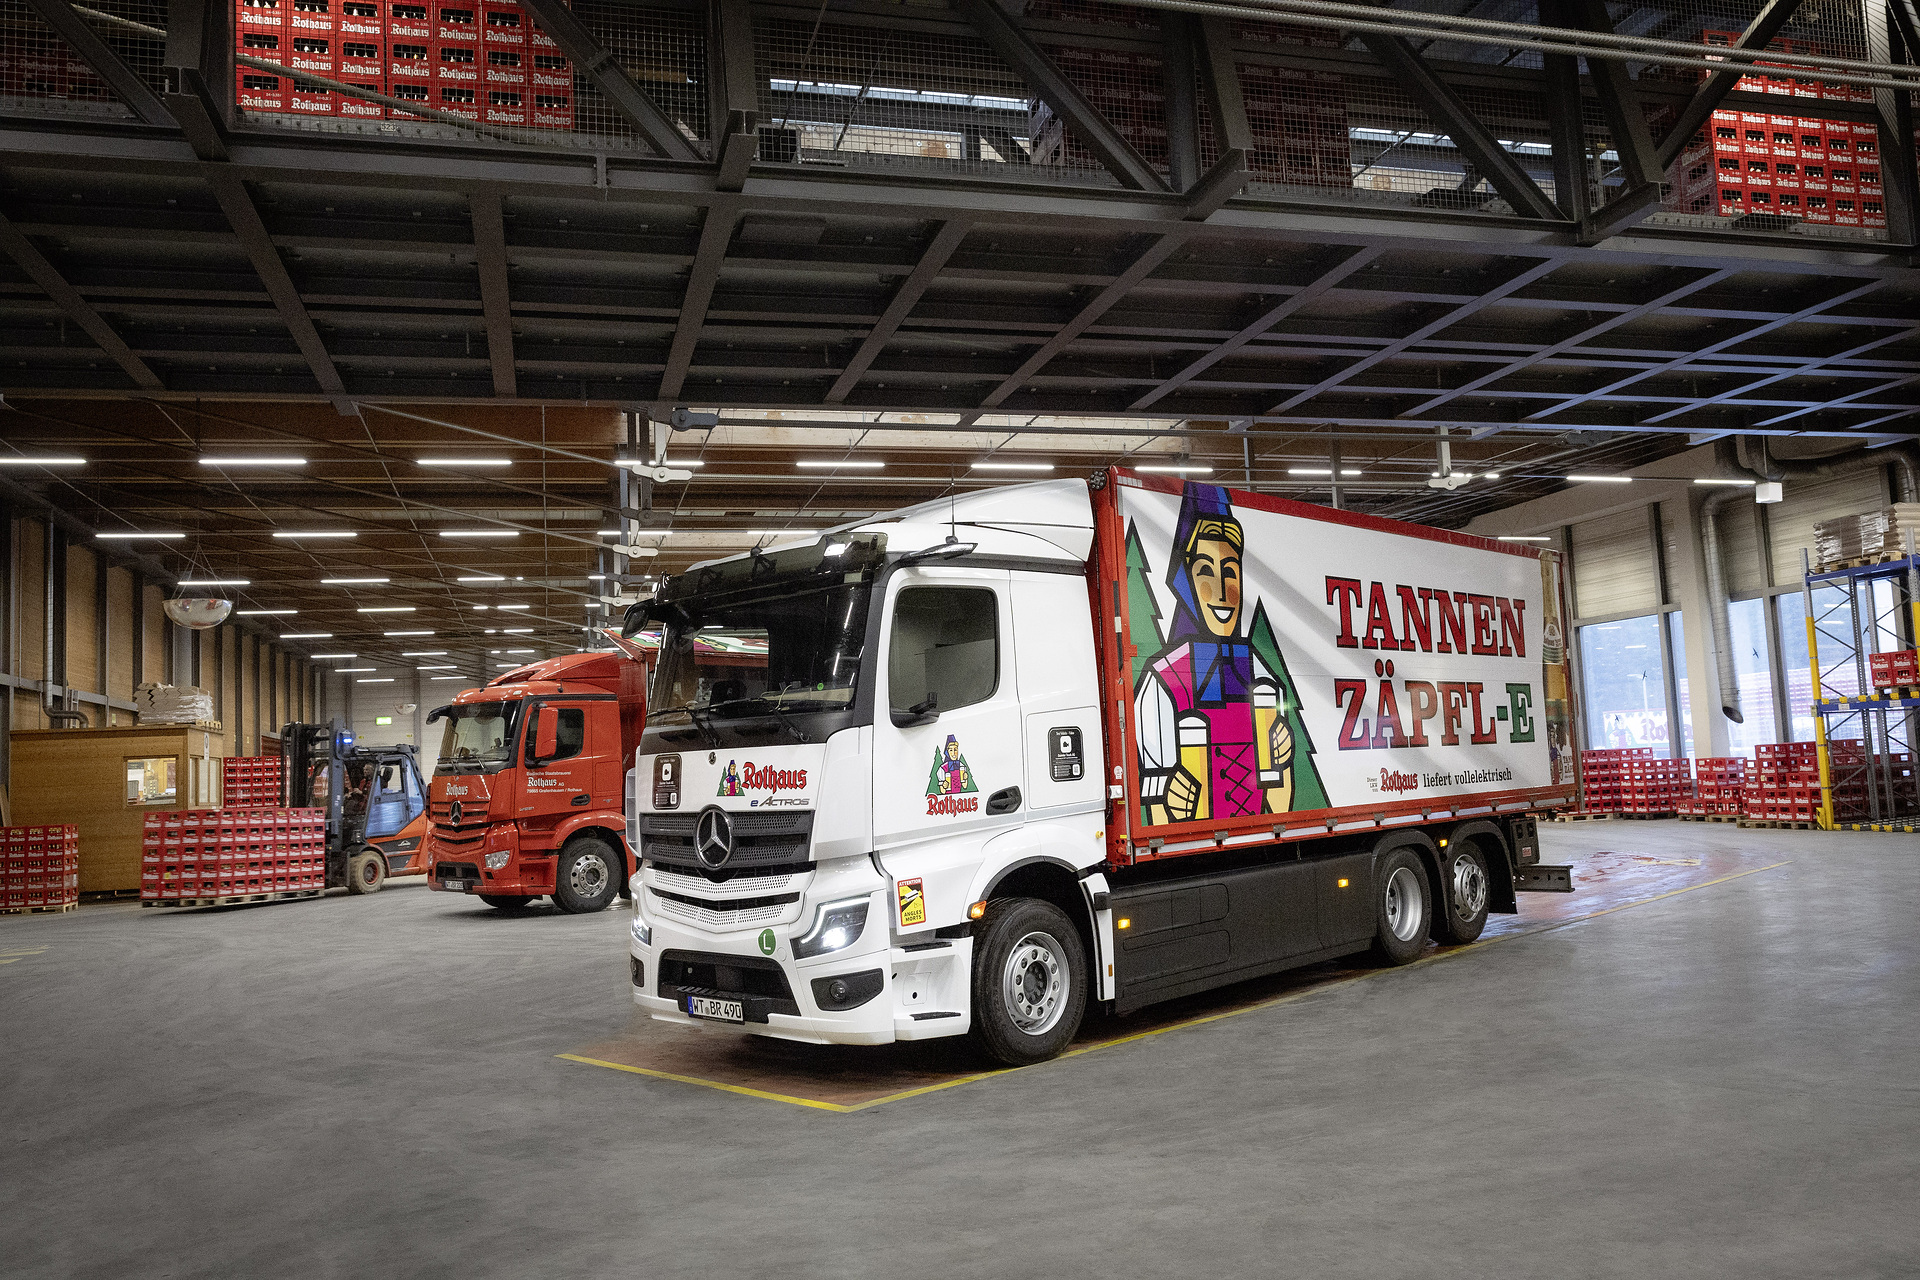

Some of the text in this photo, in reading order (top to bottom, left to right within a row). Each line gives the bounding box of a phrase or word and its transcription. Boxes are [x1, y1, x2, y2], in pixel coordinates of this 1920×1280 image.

[1325, 575, 1526, 658] TANNEN
[1334, 659, 1536, 751] ZÄPFL-E
[527, 777, 557, 788] Rothaus
[742, 761, 808, 794] Rothaus
[1380, 767, 1513, 795] Rothaus liefert vollelektrisch
[446, 783, 468, 798] Rothaus
[926, 794, 979, 817] Rothaus
[899, 878, 921, 887] ATTENTION
[763, 934, 773, 951] L
[692, 998, 742, 1019] WT BR 490
